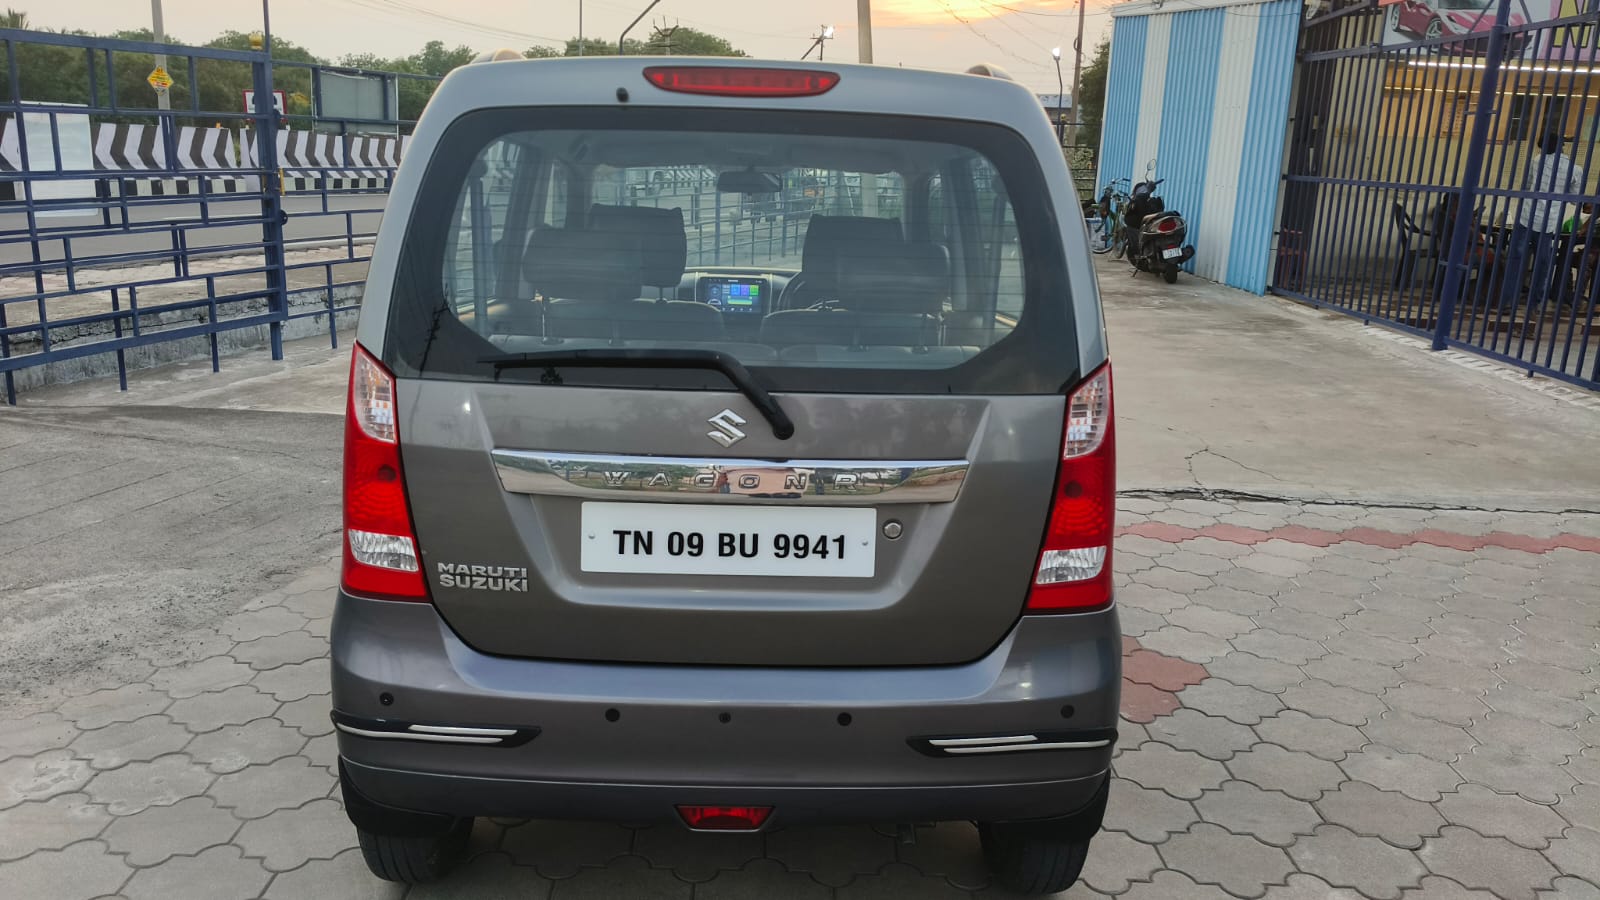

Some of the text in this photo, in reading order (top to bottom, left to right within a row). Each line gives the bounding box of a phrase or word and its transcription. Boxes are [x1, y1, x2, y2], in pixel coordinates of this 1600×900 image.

[613, 530, 846, 559] TN 09 BU 9941
[437, 562, 527, 577] MARUTI
[439, 574, 528, 592] SUZUKI
